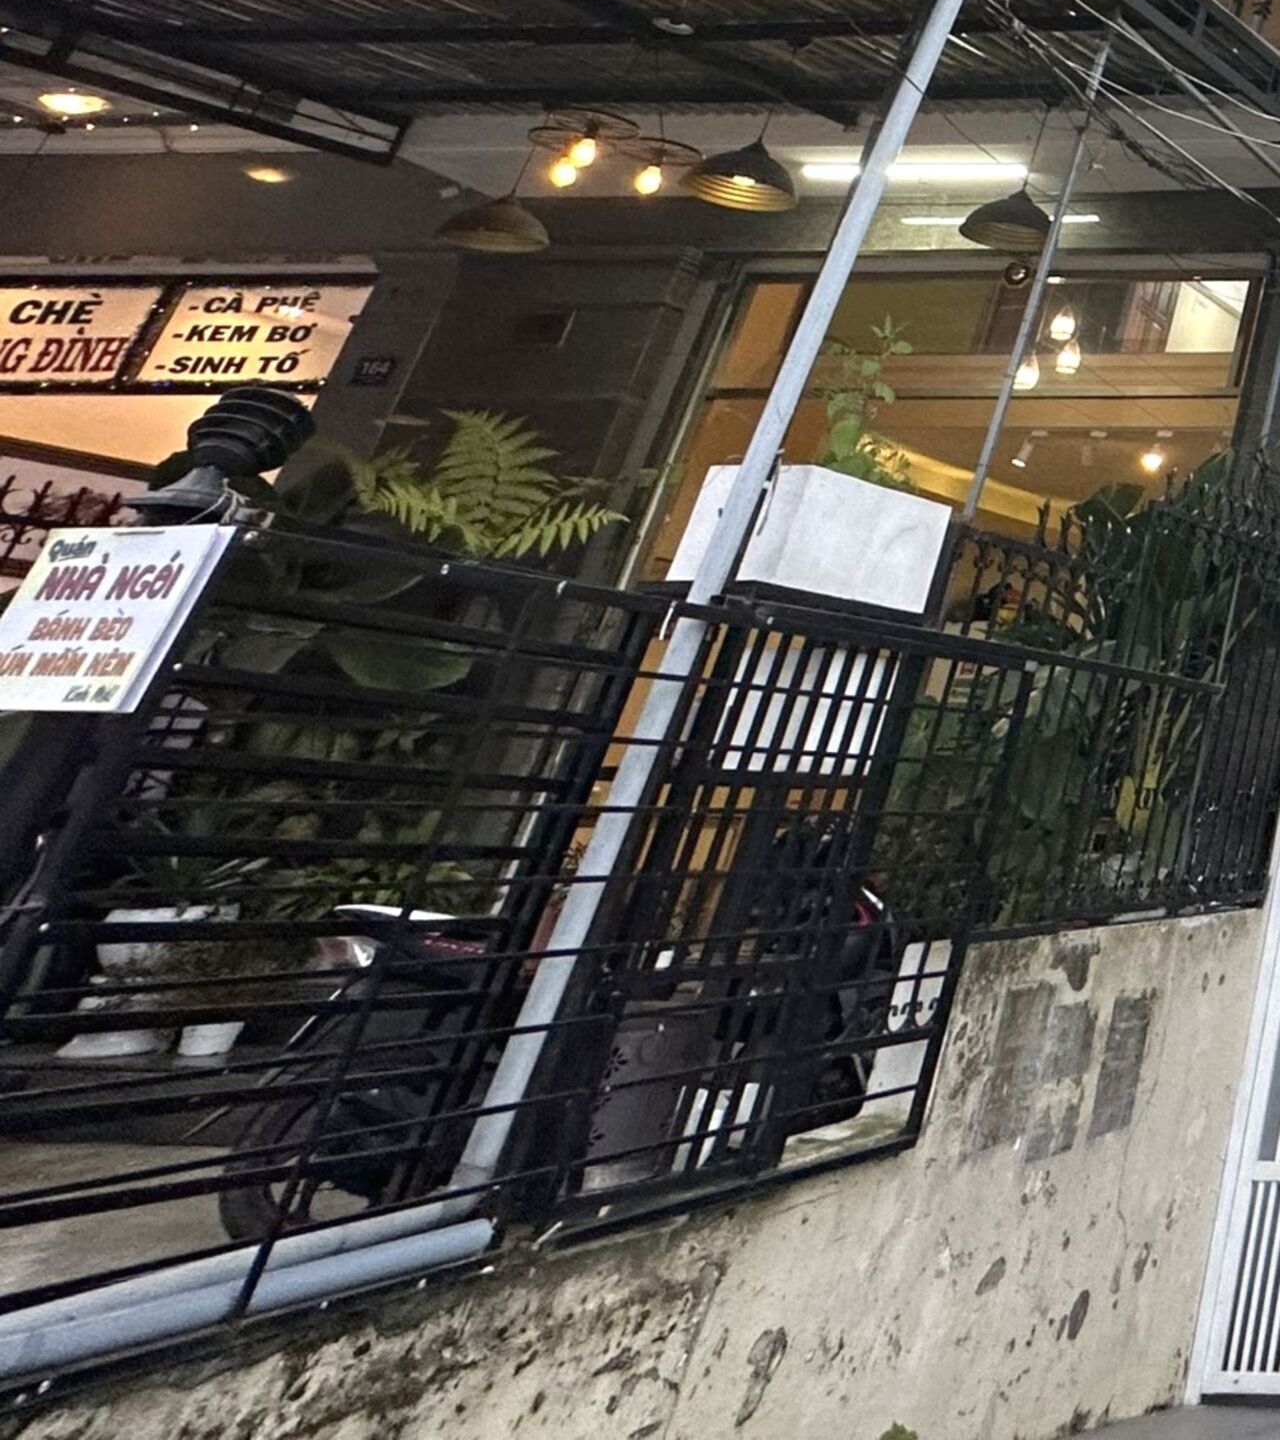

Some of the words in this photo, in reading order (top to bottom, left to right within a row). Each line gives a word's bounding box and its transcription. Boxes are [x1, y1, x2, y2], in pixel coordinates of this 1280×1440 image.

[8, 293, 104, 325] CHÈ
[254, 291, 322, 315] PHÊ
[265, 322, 318, 343] BƠ
[28, 326, 129, 373] ĐÌNH
[257, 349, 311, 375] TỐ
[48, 534, 97, 563] Quán
[34, 552, 111, 601] NHÀ
[27, 609, 91, 642] BÁNH
[87, 608, 135, 642] BÈO
